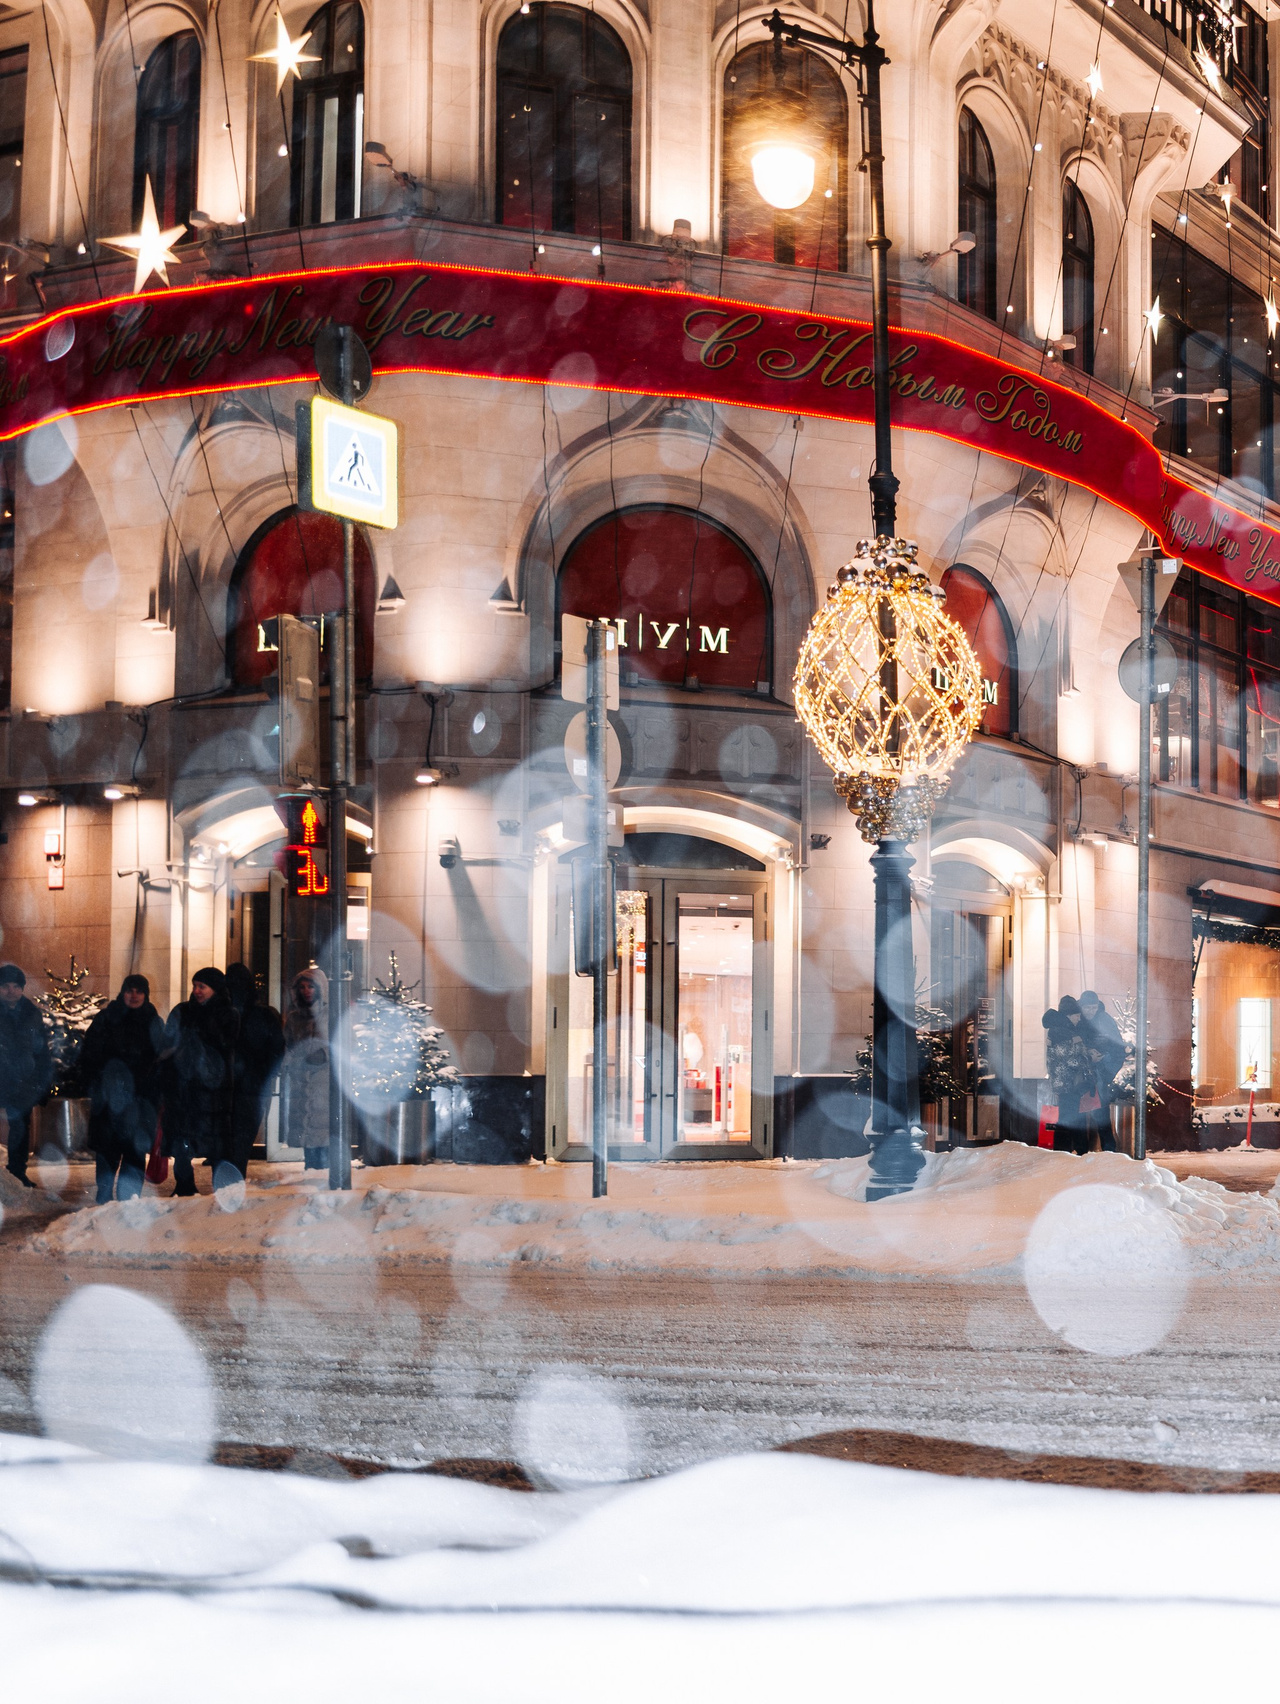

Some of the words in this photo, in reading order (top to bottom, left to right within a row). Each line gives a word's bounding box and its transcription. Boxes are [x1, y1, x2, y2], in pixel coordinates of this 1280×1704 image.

[92, 304, 228, 388] Happy
[358, 275, 496, 353] Year
[683, 309, 763, 370] С
[974, 373, 1084, 454] Годом
[1197, 508, 1241, 561] New
